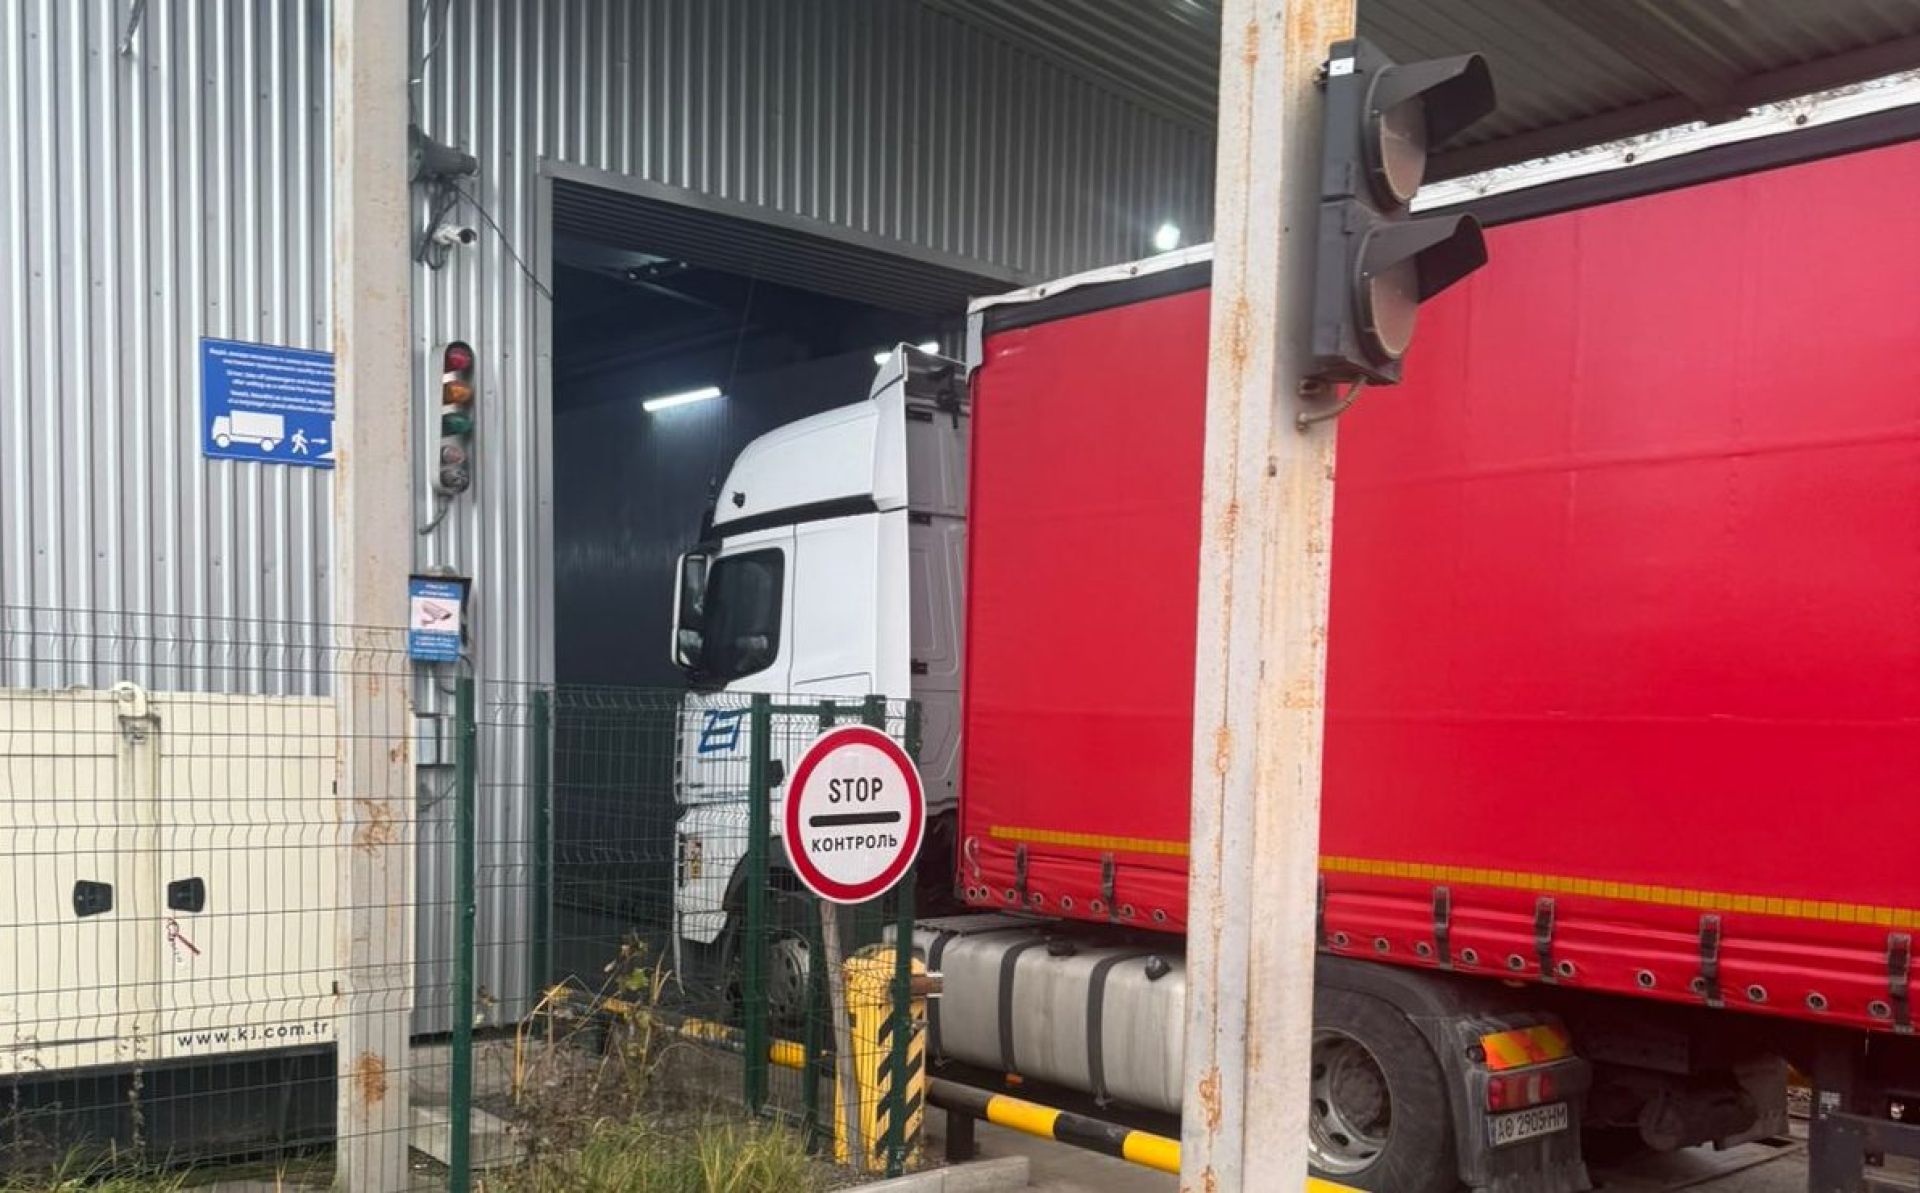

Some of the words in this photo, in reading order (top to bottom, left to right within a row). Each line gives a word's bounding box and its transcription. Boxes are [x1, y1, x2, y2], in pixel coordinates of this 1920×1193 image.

[828, 777, 883, 803] STOP
[812, 834, 898, 852] КОНТРОЛЬ
[177, 1021, 329, 1047] www.kj.com.tr
